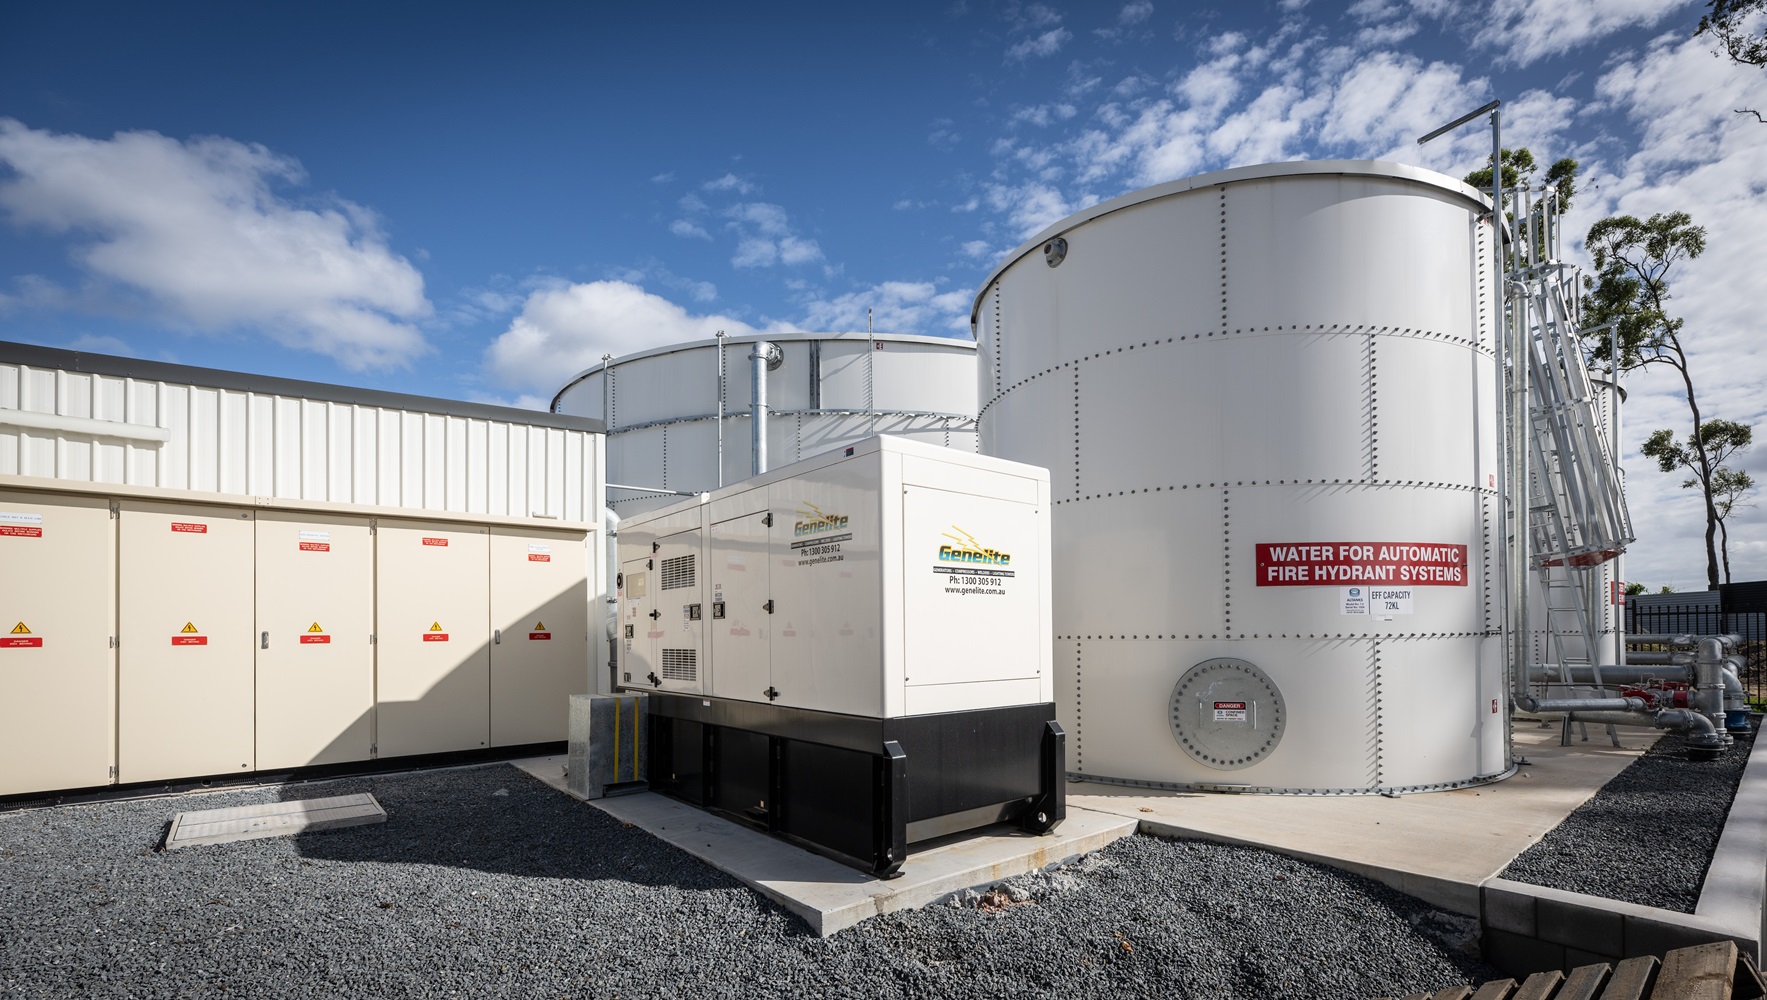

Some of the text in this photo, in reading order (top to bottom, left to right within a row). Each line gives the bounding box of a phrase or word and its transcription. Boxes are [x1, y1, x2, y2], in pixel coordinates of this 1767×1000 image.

[794, 514, 849, 537] Genelite
[809, 546, 820, 556] 1300
[821, 545, 830, 554] 305
[831, 544, 840, 553] 912
[938, 545, 1011, 566] Genelite
[1269, 545, 1460, 563] WATER FOR AUTOMATIC
[798, 554, 844, 567] www.genelite.com.au
[1267, 565, 1461, 582] FIRE HYDRANT SYSTEMS
[949, 575, 1001, 586] Ph: 1300 305 912
[945, 587, 1006, 596] www.genelite.com.au
[1371, 591, 1411, 600] EFF CAPACITY
[1385, 601, 1399, 610] 72KL
